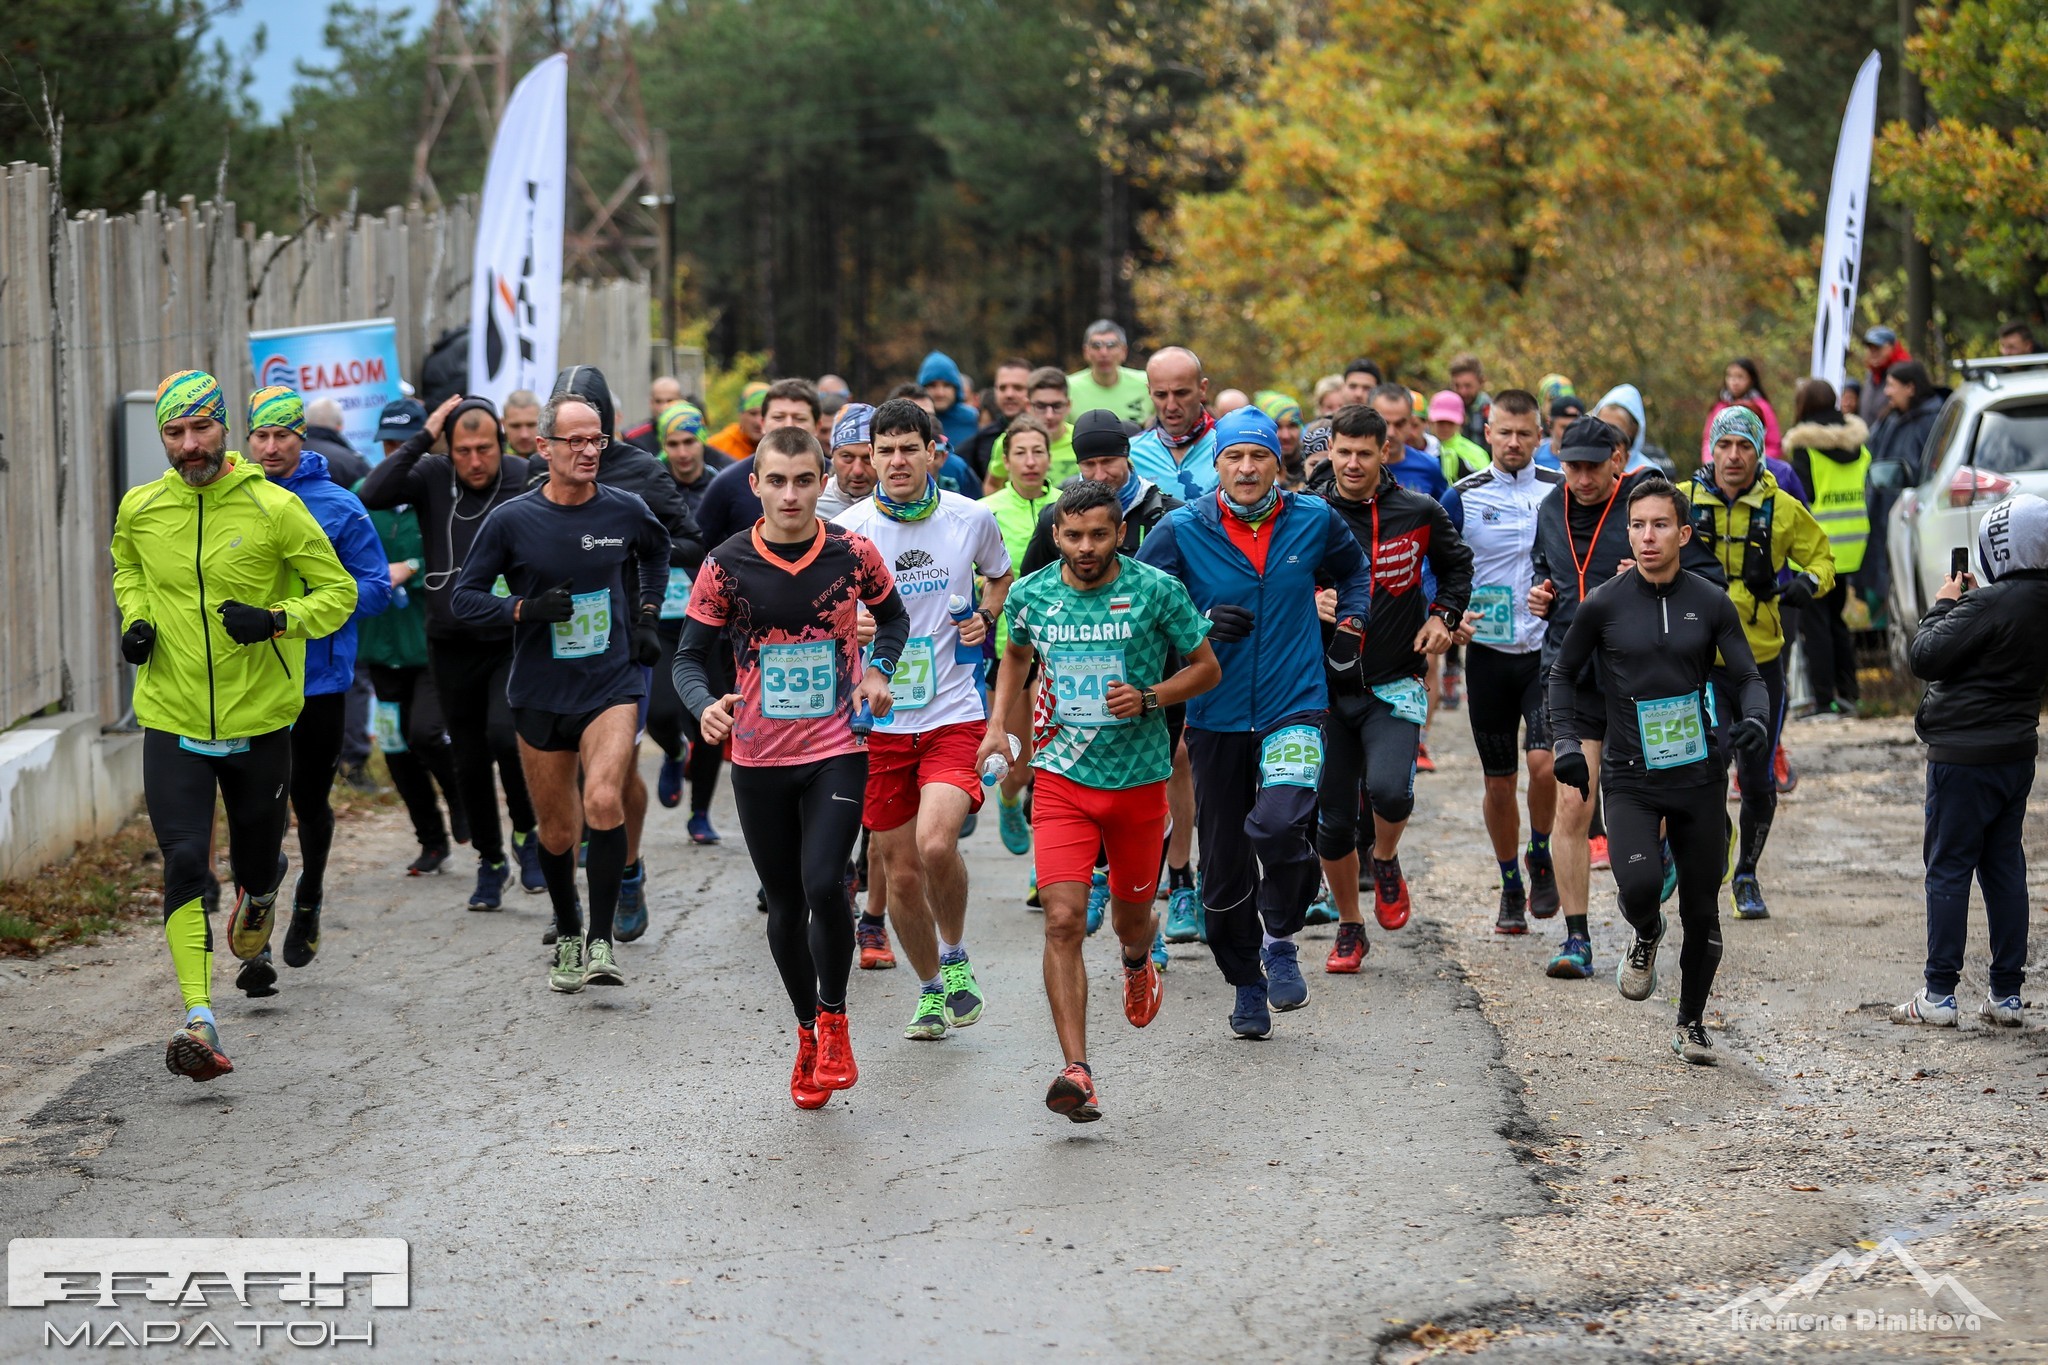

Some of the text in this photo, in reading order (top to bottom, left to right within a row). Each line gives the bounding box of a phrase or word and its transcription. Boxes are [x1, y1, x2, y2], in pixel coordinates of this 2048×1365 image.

[300, 358, 387, 391] ЕЛДОМ
[1988, 500, 2012, 562] STREE
[895, 567, 950, 583] ARATHON
[900, 579, 950, 596] OVDIV
[1047, 621, 1133, 642] BULGARIA
[766, 665, 832, 693] 335
[893, 659, 929, 685] 27
[1644, 714, 1700, 746] 525
[1265, 743, 1321, 767] 522
